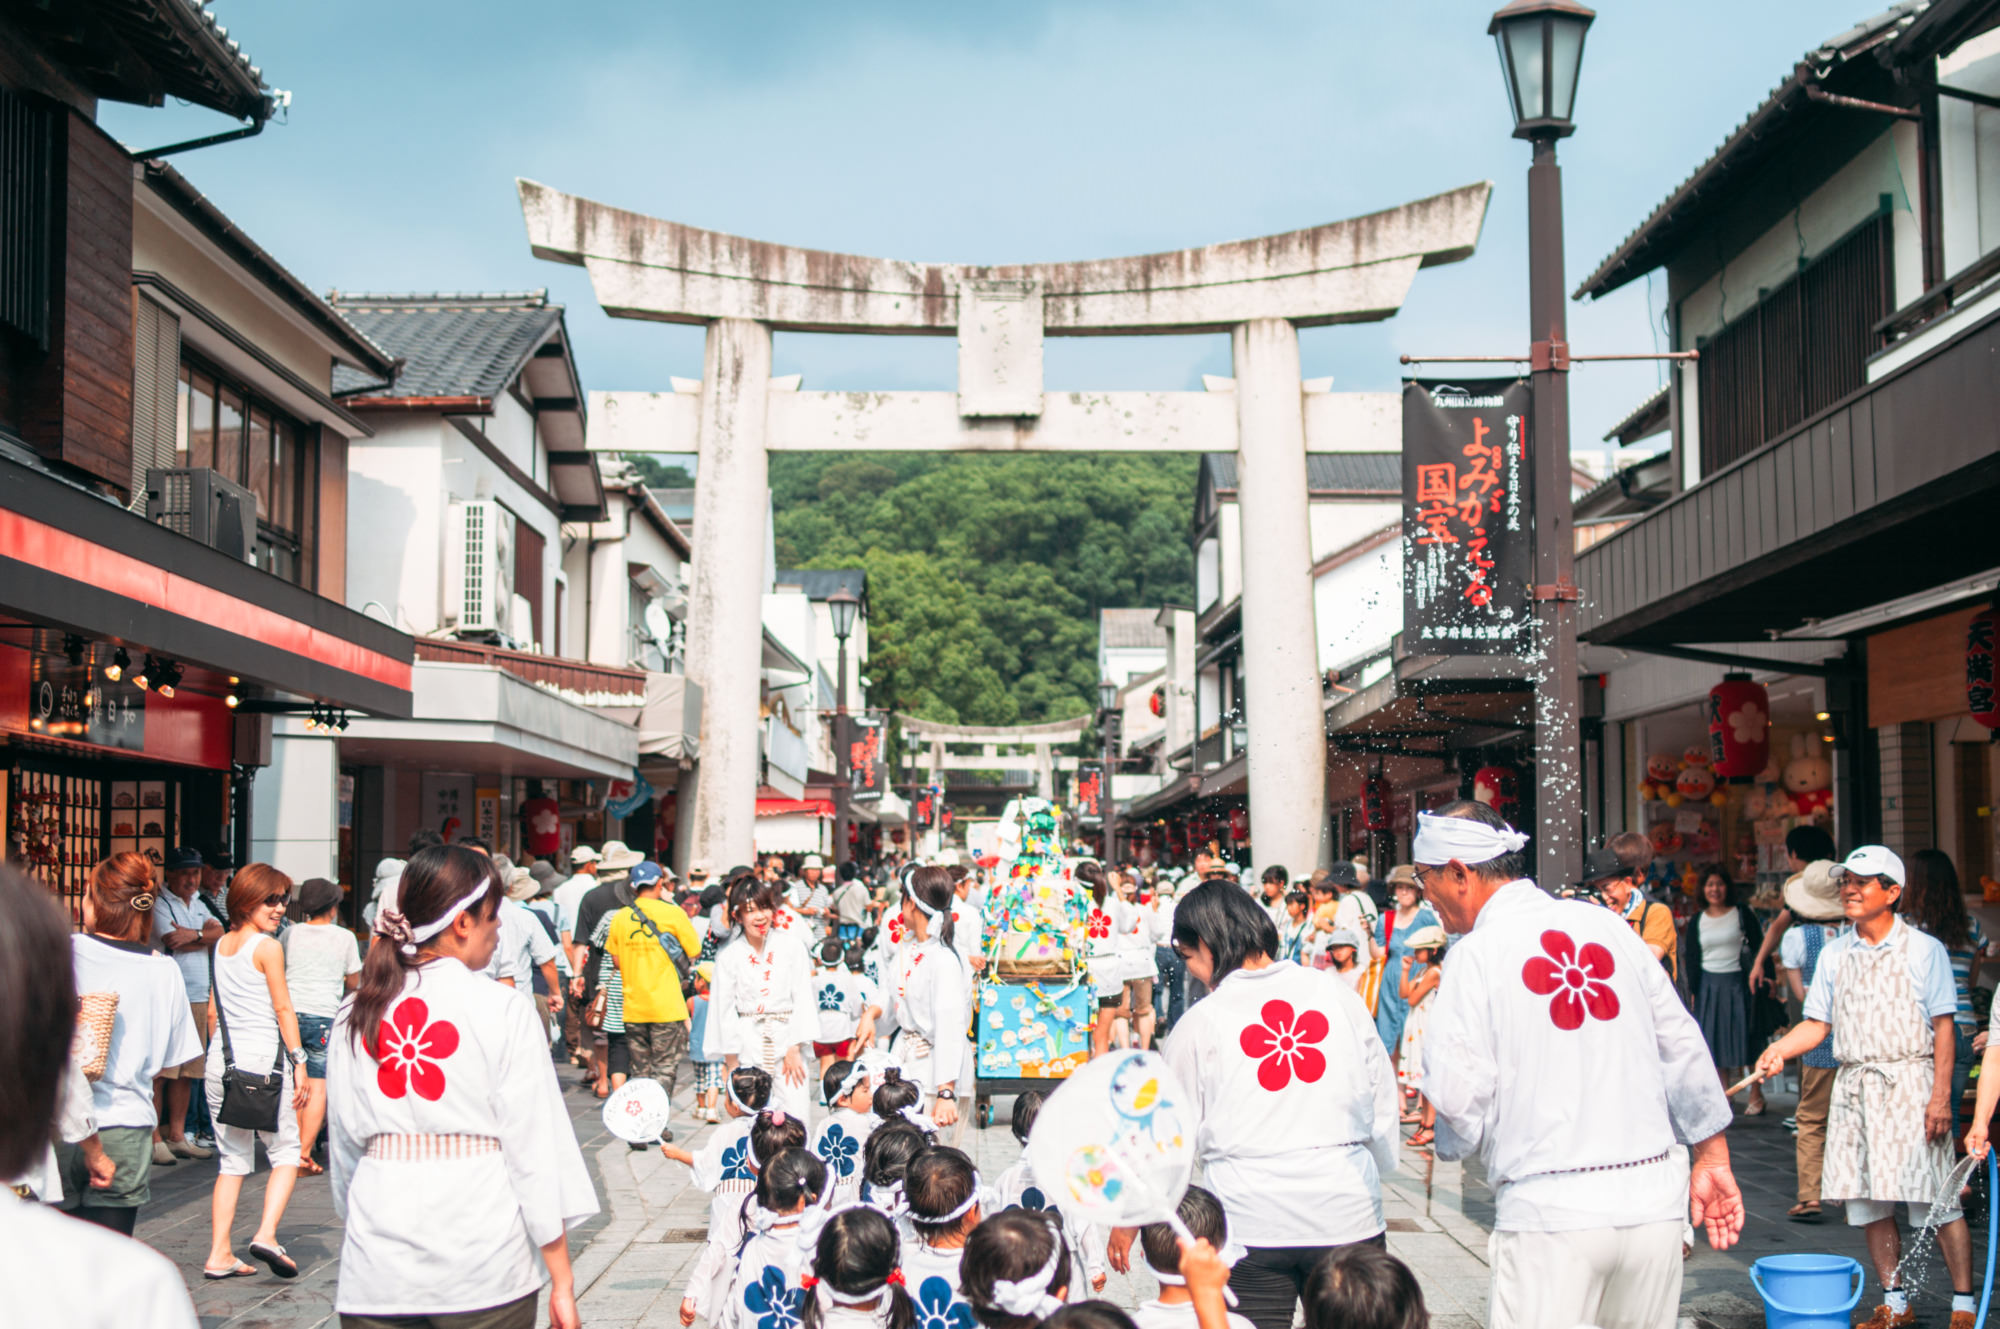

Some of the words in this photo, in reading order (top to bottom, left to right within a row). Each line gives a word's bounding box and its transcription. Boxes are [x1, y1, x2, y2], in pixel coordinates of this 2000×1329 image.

[1434, 396, 1504, 408] 九州国立博物館
[1416, 462, 1459, 545] 国宝
[1458, 417, 1505, 606] よみがえる
[1506, 414, 1521, 531] 守り伝える日本の美
[1421, 624, 1514, 640] 太宰府観光協会
[1966, 620, 1995, 713] 天満宮
